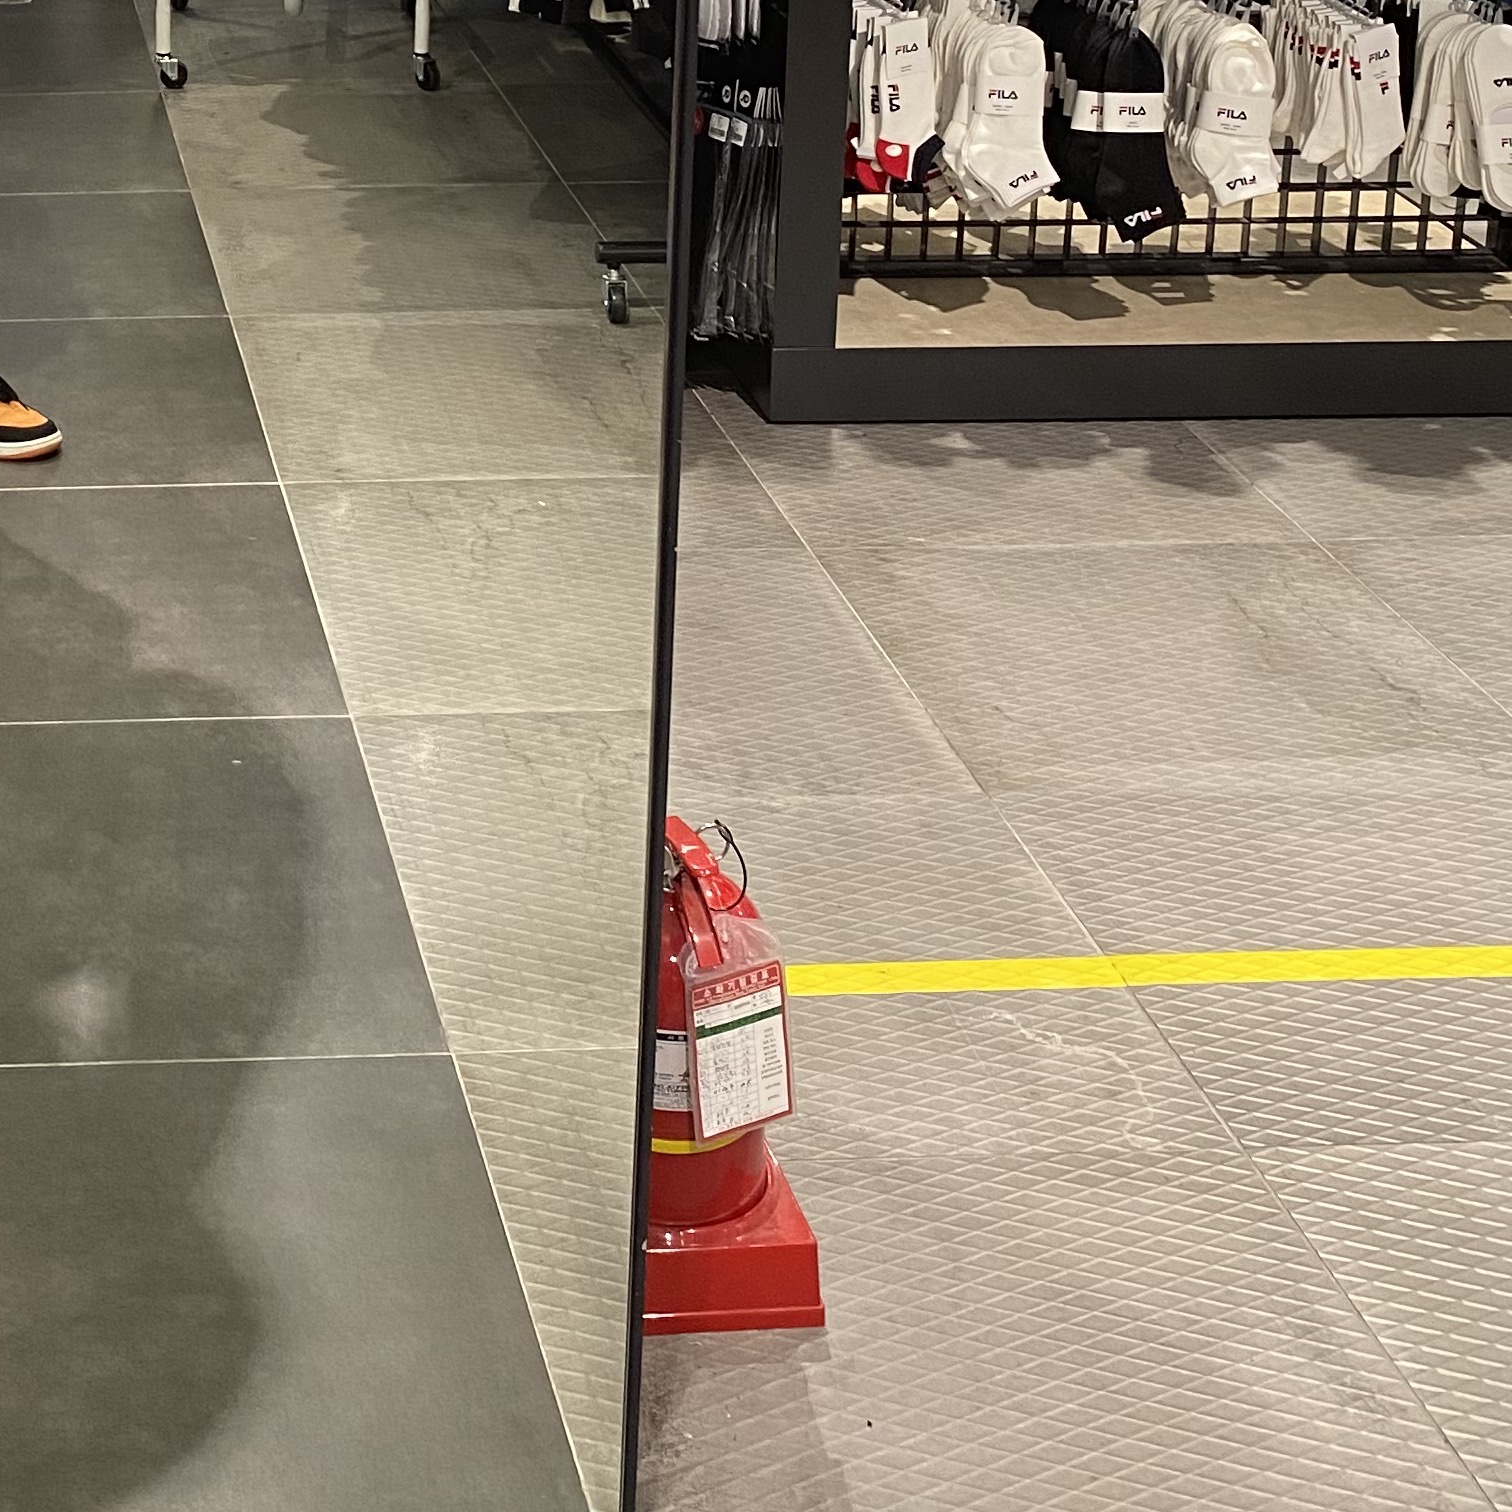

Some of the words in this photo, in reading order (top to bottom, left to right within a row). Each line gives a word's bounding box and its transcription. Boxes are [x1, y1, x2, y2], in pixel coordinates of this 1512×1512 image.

[895, 42, 919, 56] FILA
[1368, 48, 1391, 64] FILA
[887, 84, 901, 113] FILA
[988, 89, 1019, 100] FILA
[1090, 105, 1104, 116] FI
[1119, 106, 1147, 116] FILA
[1217, 107, 1248, 121] FILA
[1009, 170, 1039, 189] FILA
[1226, 175, 1257, 190] FILA
[1123, 206, 1163, 227] FILA
